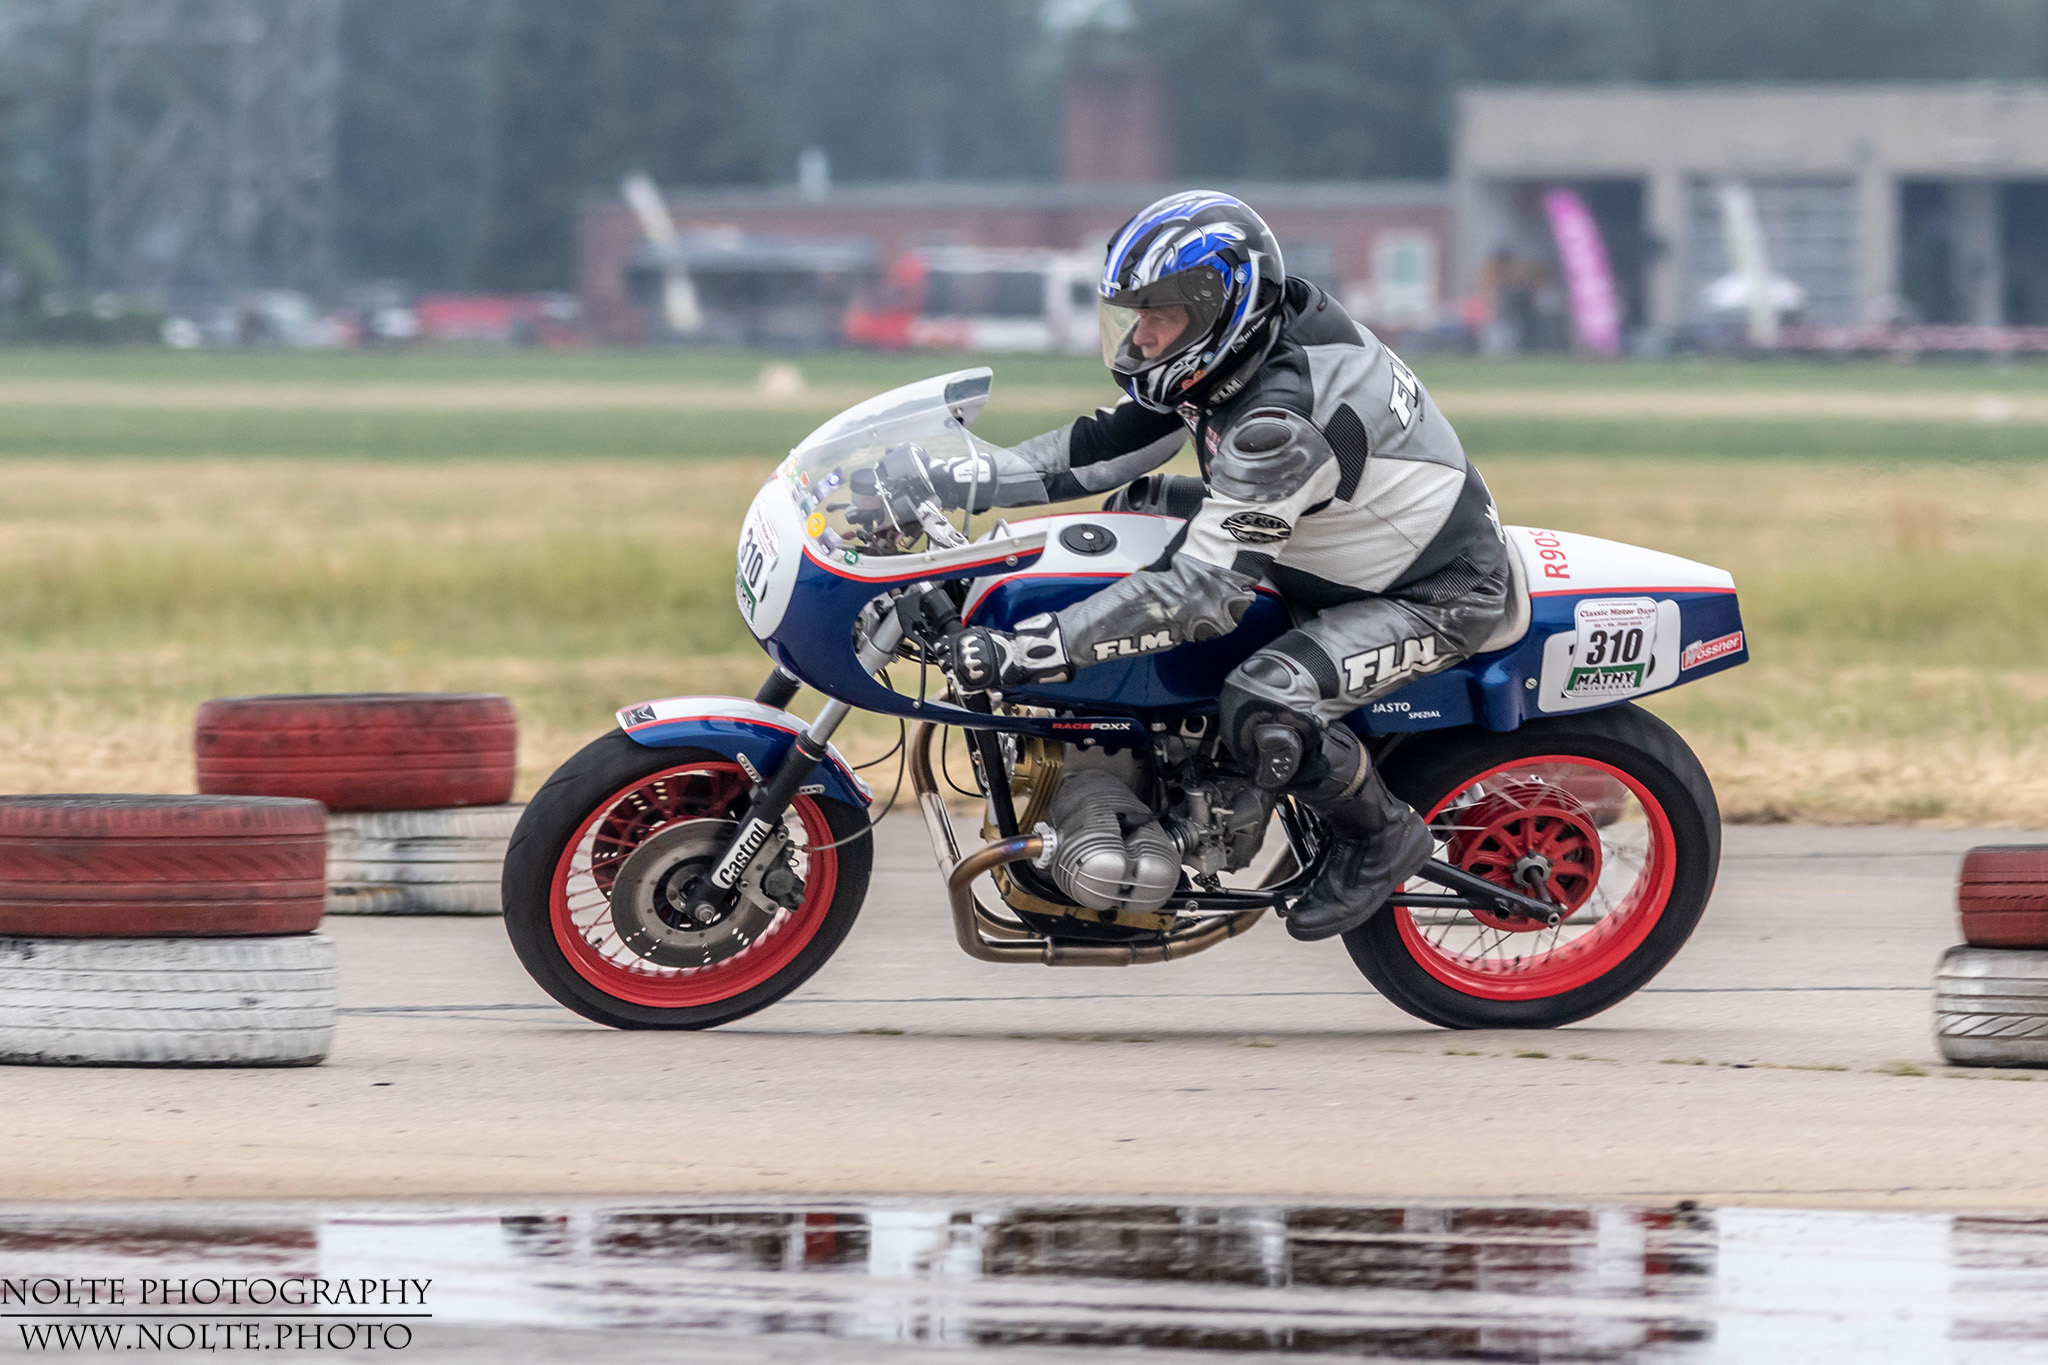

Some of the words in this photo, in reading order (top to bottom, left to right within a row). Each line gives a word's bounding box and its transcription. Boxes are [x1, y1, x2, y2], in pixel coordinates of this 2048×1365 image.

[1381, 343, 1422, 430] FL
[1528, 530, 1570, 579] R90S
[1580, 608, 1609, 618] Classic
[1610, 607, 1635, 616] Motor
[1092, 629, 1174, 661] FLM
[1586, 628, 1644, 665] 310
[1343, 634, 1438, 691] FLM
[1577, 668, 1634, 686] MATHY
[1371, 702, 1411, 713] JASTO
[1408, 710, 1441, 719] SPEZIAL
[719, 822, 768, 885] Castrol
